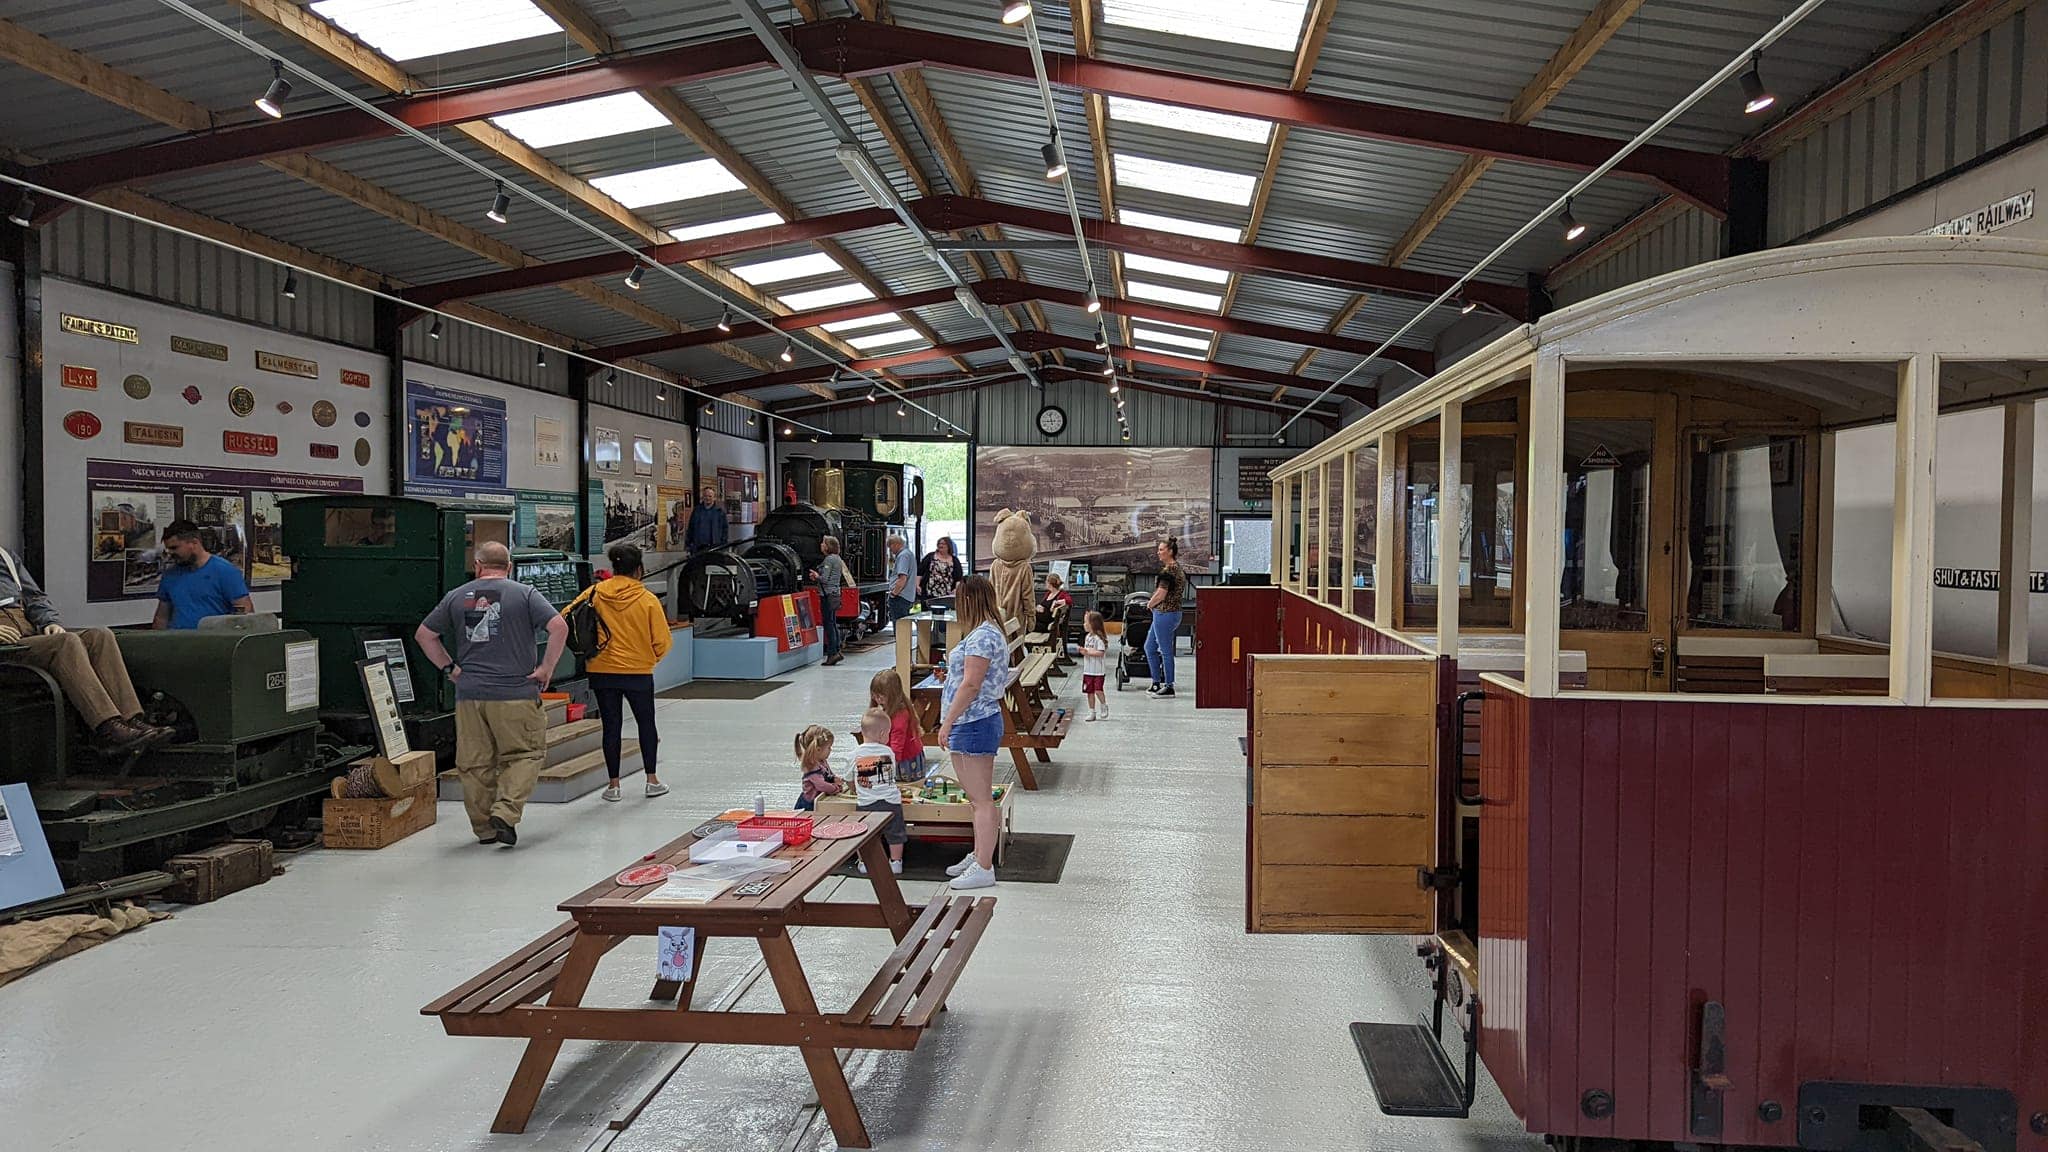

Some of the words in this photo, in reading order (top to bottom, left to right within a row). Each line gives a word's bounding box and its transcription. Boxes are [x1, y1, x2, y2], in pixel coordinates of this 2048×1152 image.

[1977, 195, 2031, 232] RAILWAY
[64, 317, 103, 334] FAIRLIE'S
[105, 326, 135, 340] PATENT
[68, 368, 93, 386] LYN
[76, 424, 92, 436] 190
[135, 427, 179, 441] TALIESIN
[228, 434, 275, 451] RUSSELL
[2029, 573, 2045, 591] TE
[269, 674, 285, 687] 264
